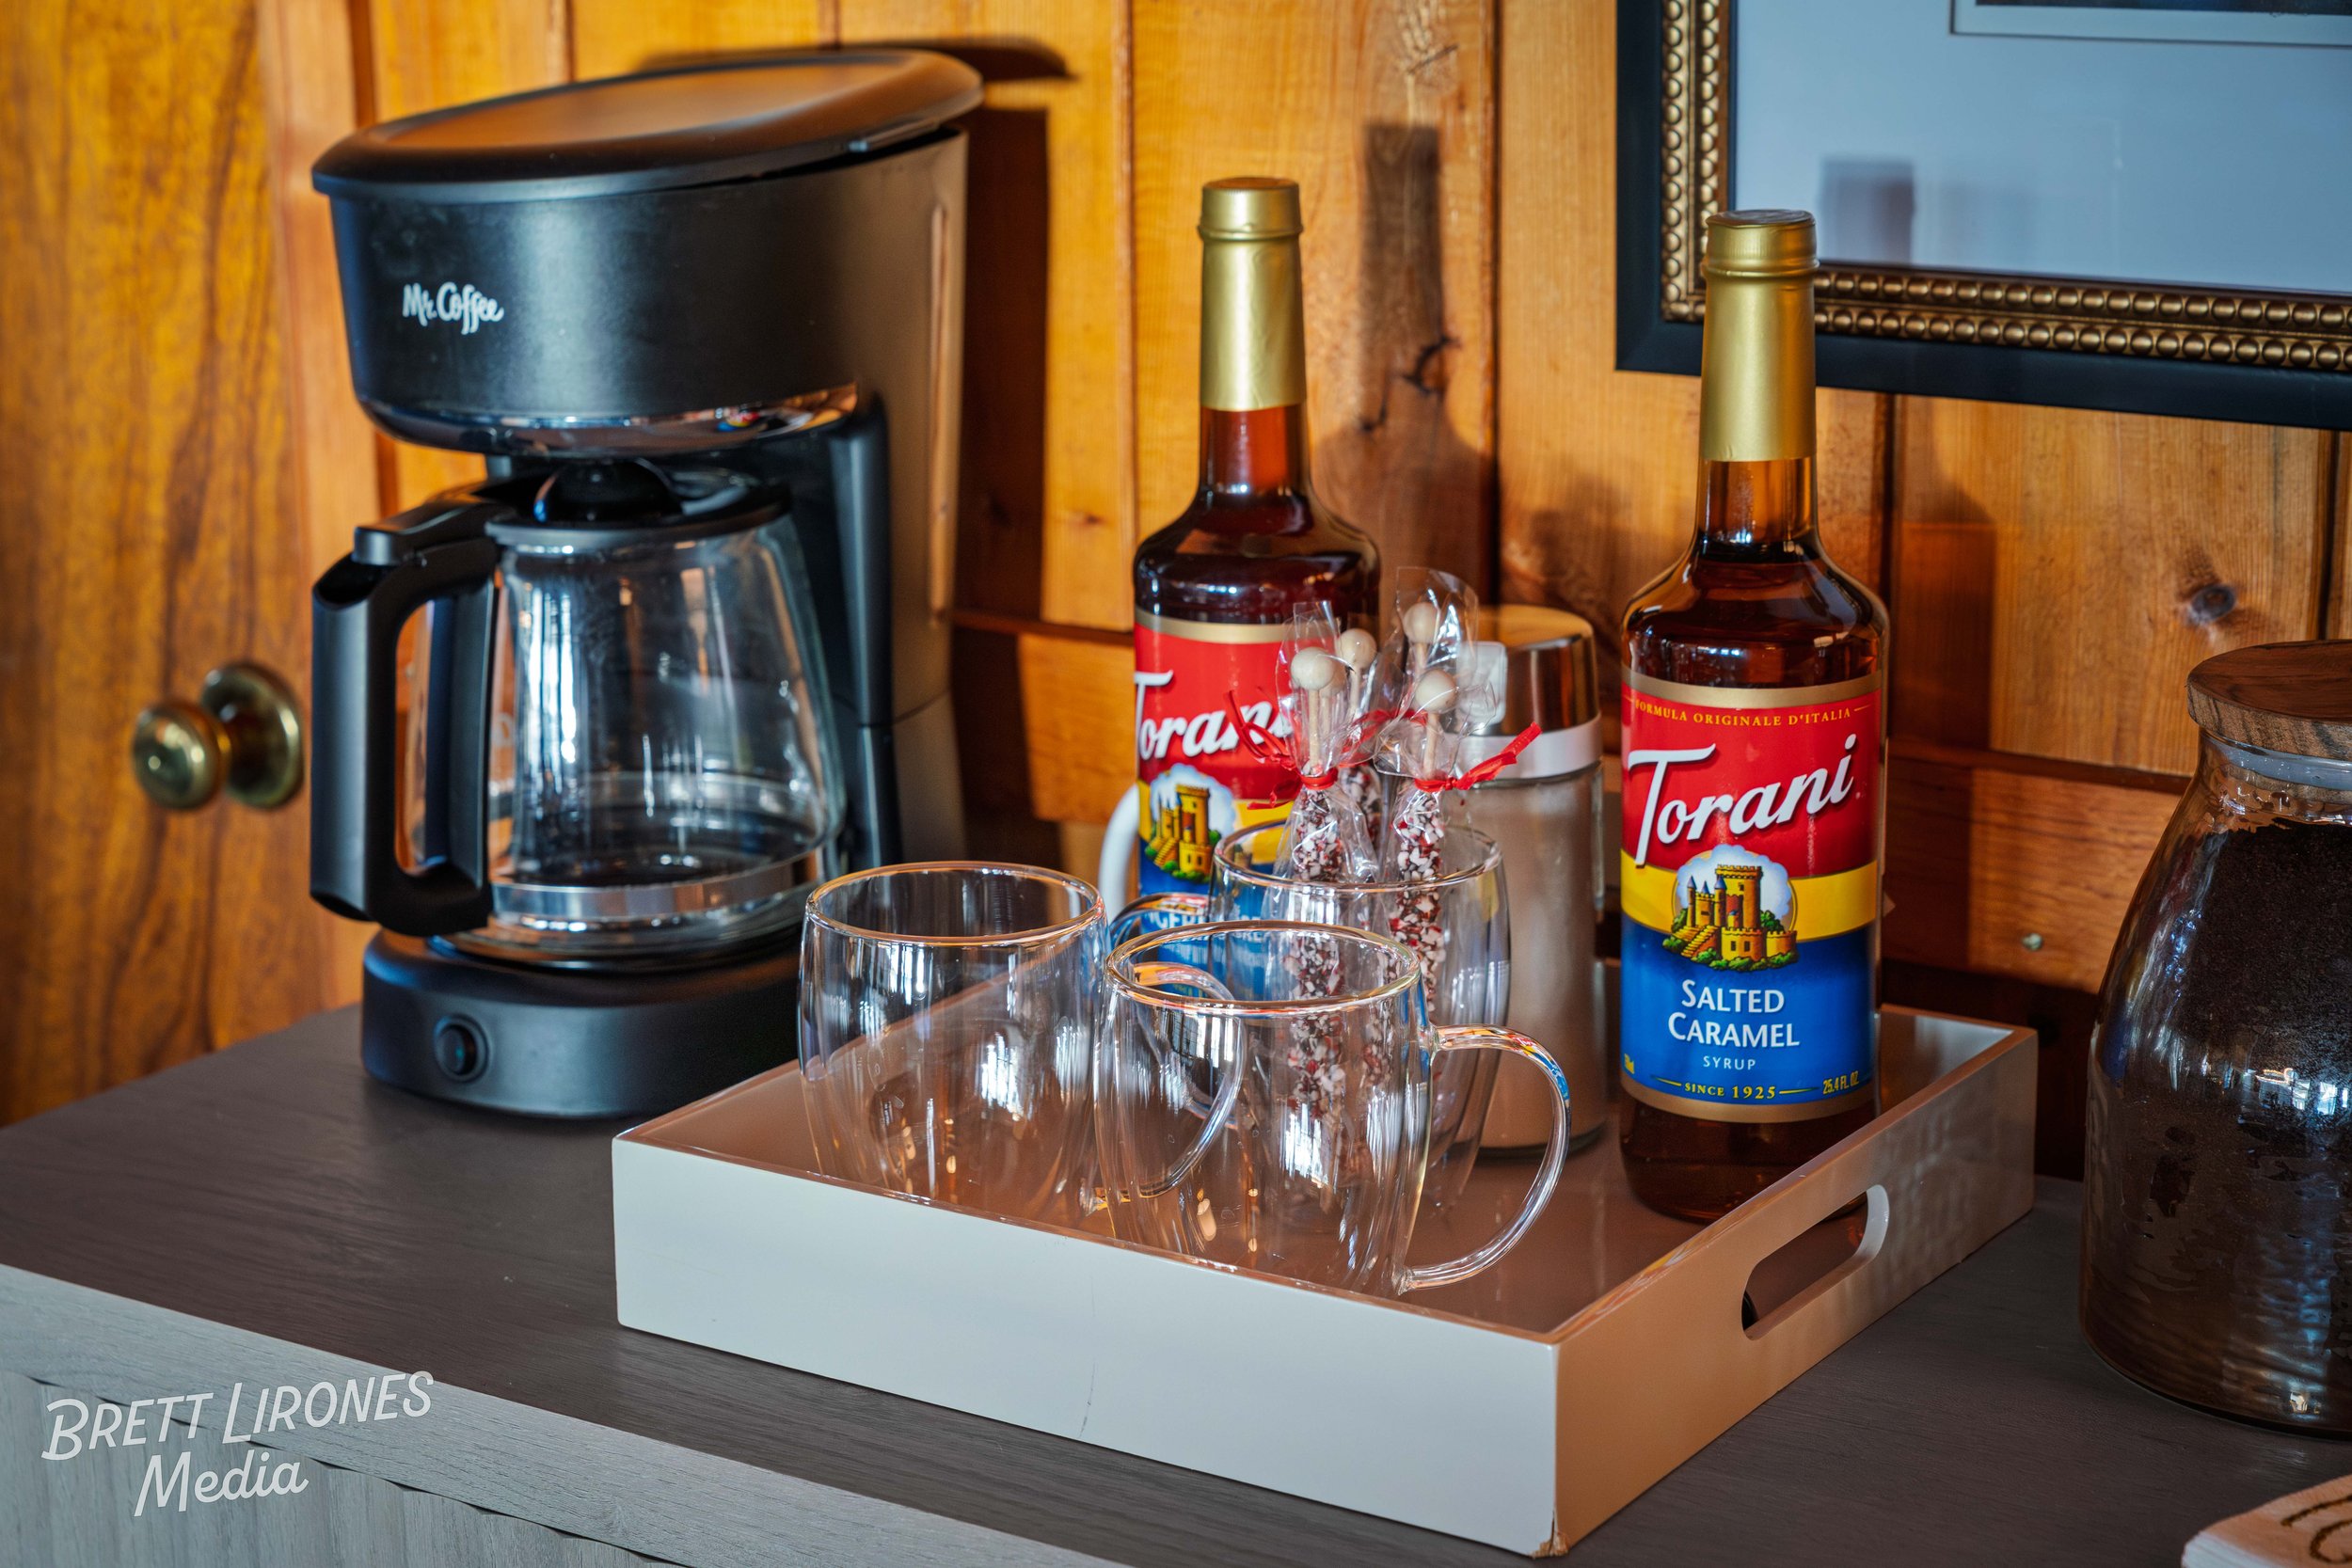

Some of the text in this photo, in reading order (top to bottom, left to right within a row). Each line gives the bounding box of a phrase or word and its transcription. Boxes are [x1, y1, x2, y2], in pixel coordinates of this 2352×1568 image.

[403, 281, 505, 335] Mr. Coffee
[1692, 712, 1783, 727] ORIGINALE
[1788, 706, 1851, 726] D'ITALIA
[1627, 733, 1860, 866] Torani
[1681, 978, 1786, 1014] SALTED
[1667, 1011, 1801, 1049] CARAMEL
[1702, 1054, 1757, 1071] SYRUP
[1684, 1082, 1776, 1100] SINCE 1925
